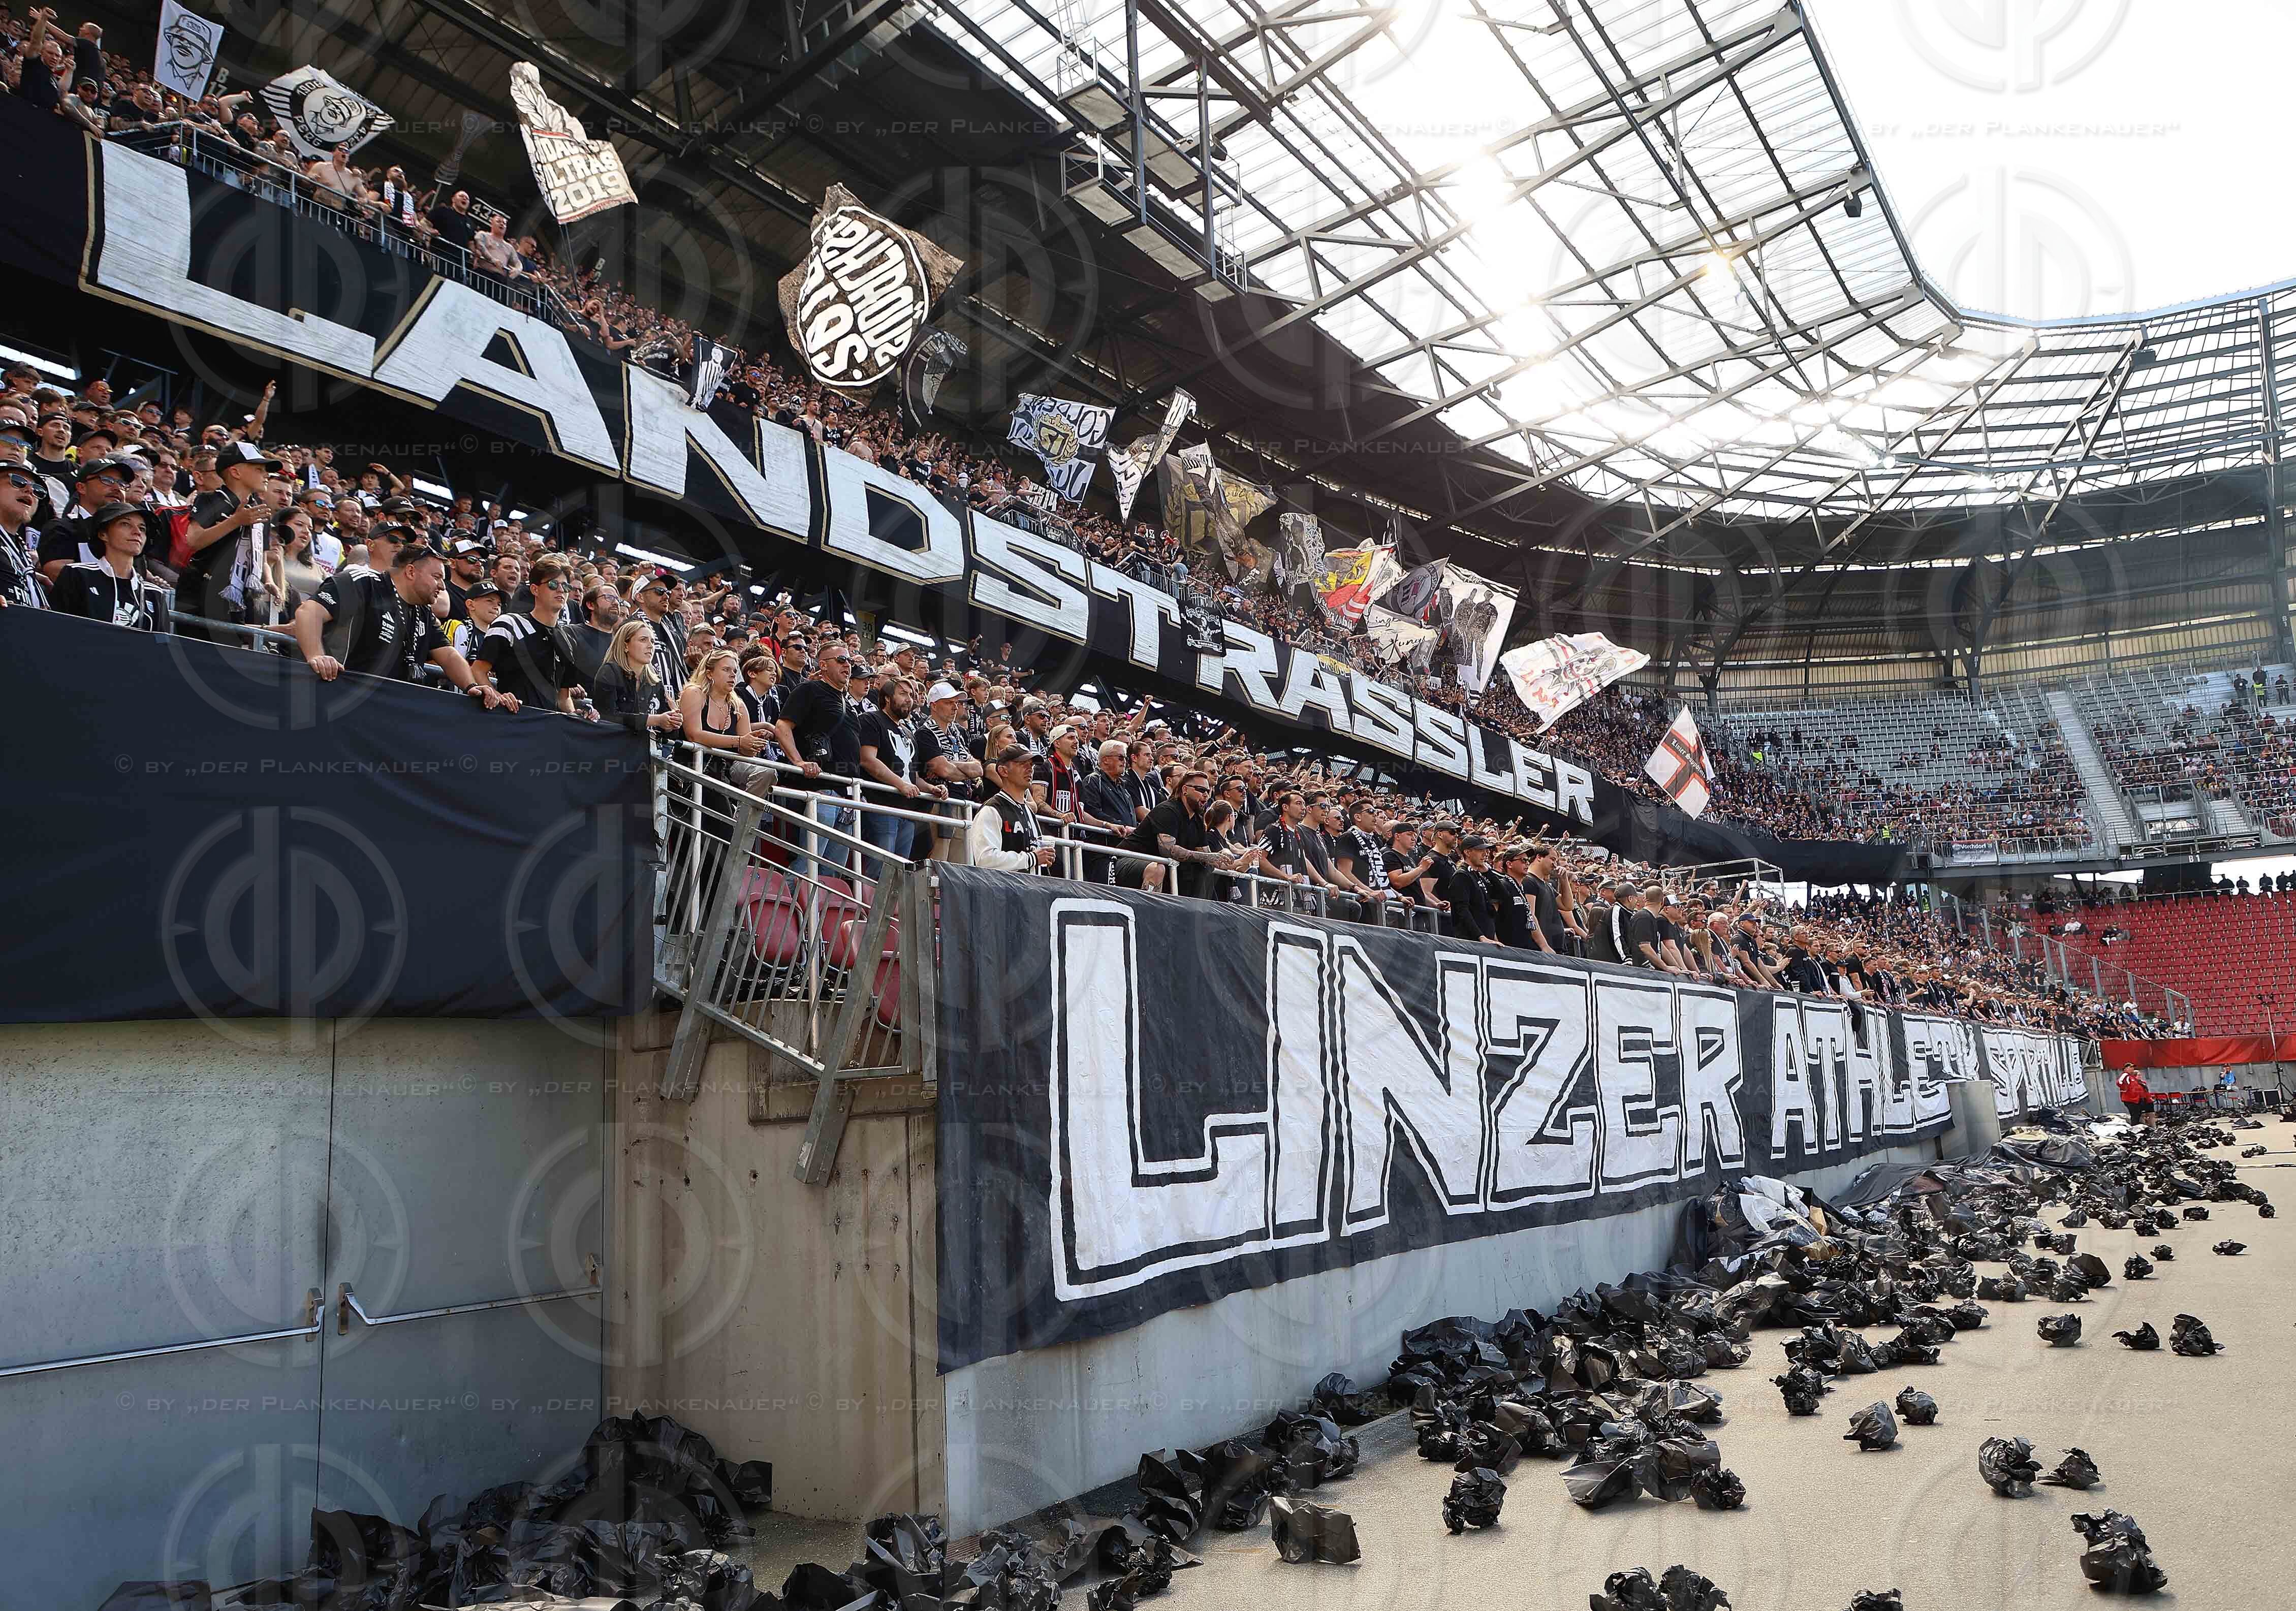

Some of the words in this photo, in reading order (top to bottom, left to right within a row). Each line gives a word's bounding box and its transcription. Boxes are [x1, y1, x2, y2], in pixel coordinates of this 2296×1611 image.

[548, 170, 626, 214] 2019
[80, 131, 1594, 827] LANDSTRASSLER
[2188, 855, 2194, 863] B
[2195, 854, 2200, 862] 1
[1049, 898, 1746, 1302] LINZER
